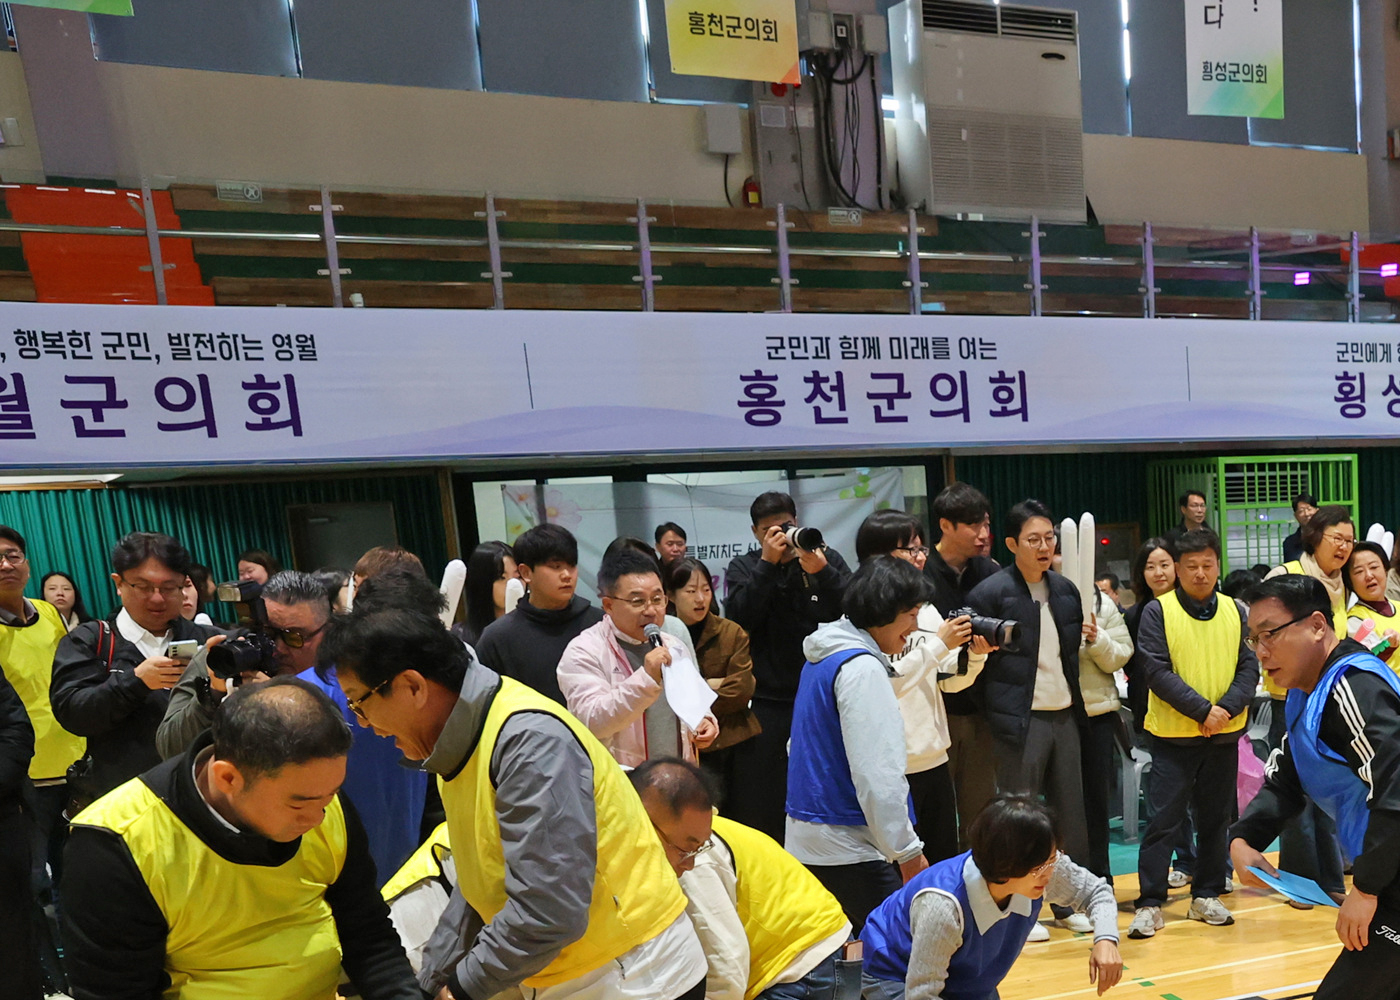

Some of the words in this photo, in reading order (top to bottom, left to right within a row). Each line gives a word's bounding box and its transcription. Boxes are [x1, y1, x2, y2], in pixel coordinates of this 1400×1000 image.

[688, 11, 778, 43] 홍천군의회
[1202, 60, 1268, 84] 횡성군의회
[13, 328, 93, 361] 행복한
[101, 331, 161, 365] 군민,
[168, 331, 265, 361] 발전하는
[272, 333, 318, 361] 영월
[765, 334, 831, 360] 군민과
[839, 334, 881, 360] 함께
[889, 336, 950, 360] 미래를
[958, 336, 997, 361] 여는
[1336, 342, 1392, 364] 군민에게
[737, 369, 1029, 427] 홍천군의회
